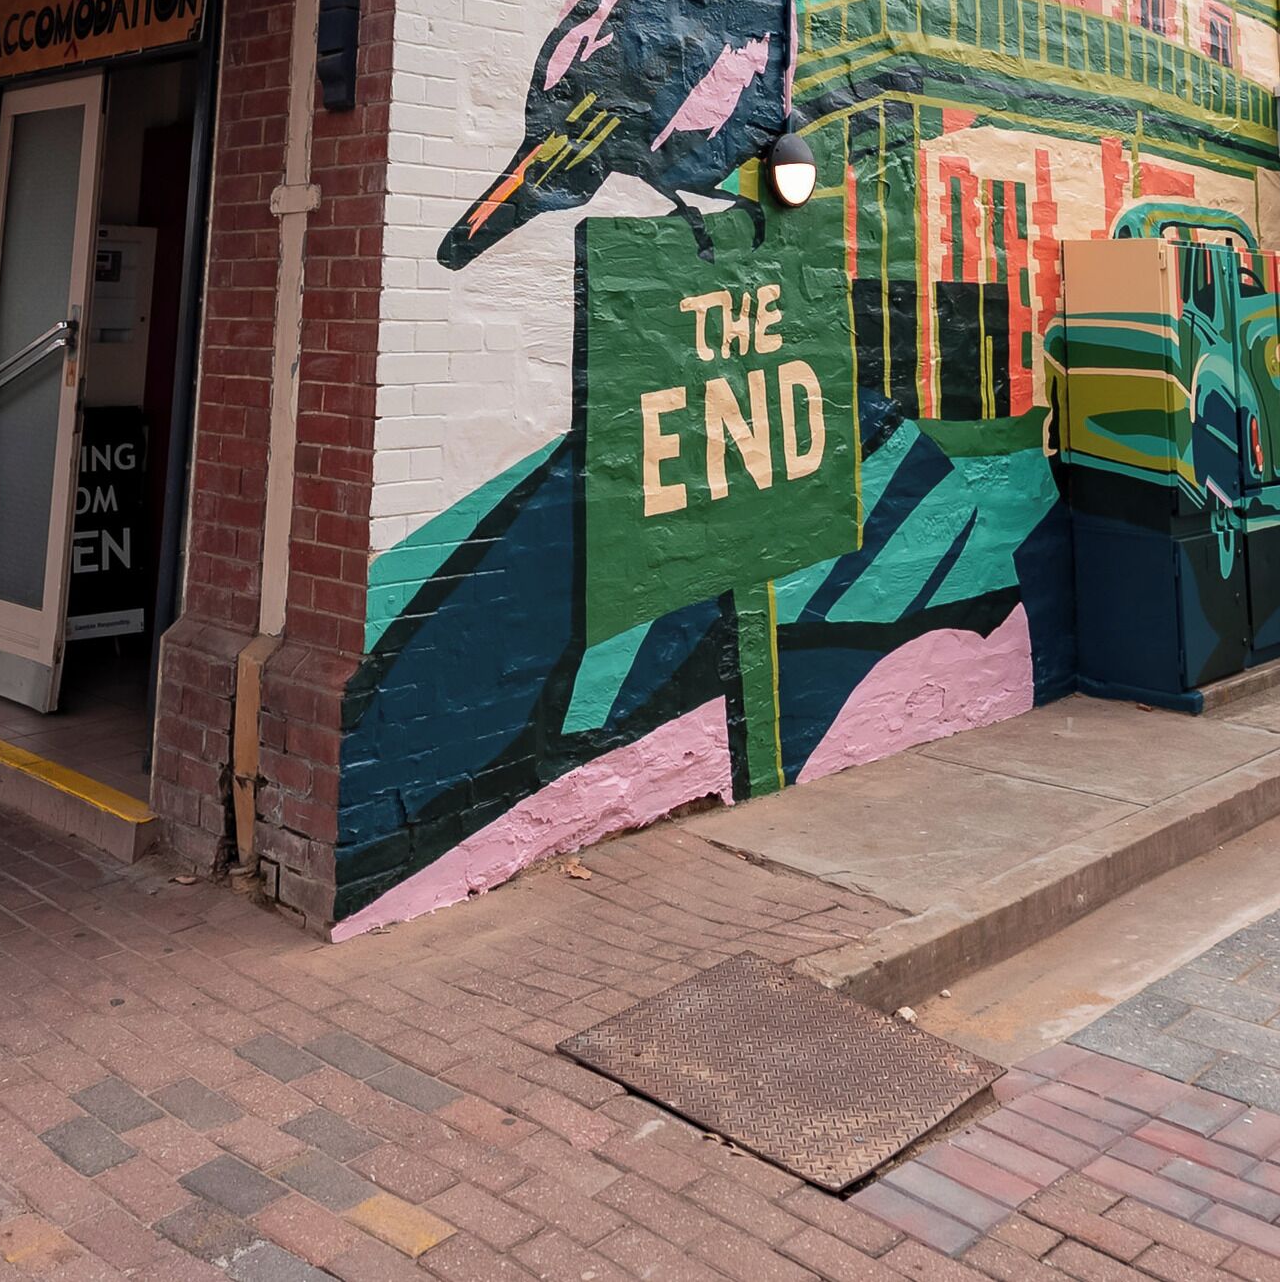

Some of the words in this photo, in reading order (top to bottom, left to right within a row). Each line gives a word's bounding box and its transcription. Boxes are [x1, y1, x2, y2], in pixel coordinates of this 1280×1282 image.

[679, 284, 784, 362] THE
[81, 443, 136, 473] ING
[640, 359, 827, 518] END
[75, 485, 119, 515] OM
[73, 527, 131, 574] EN
